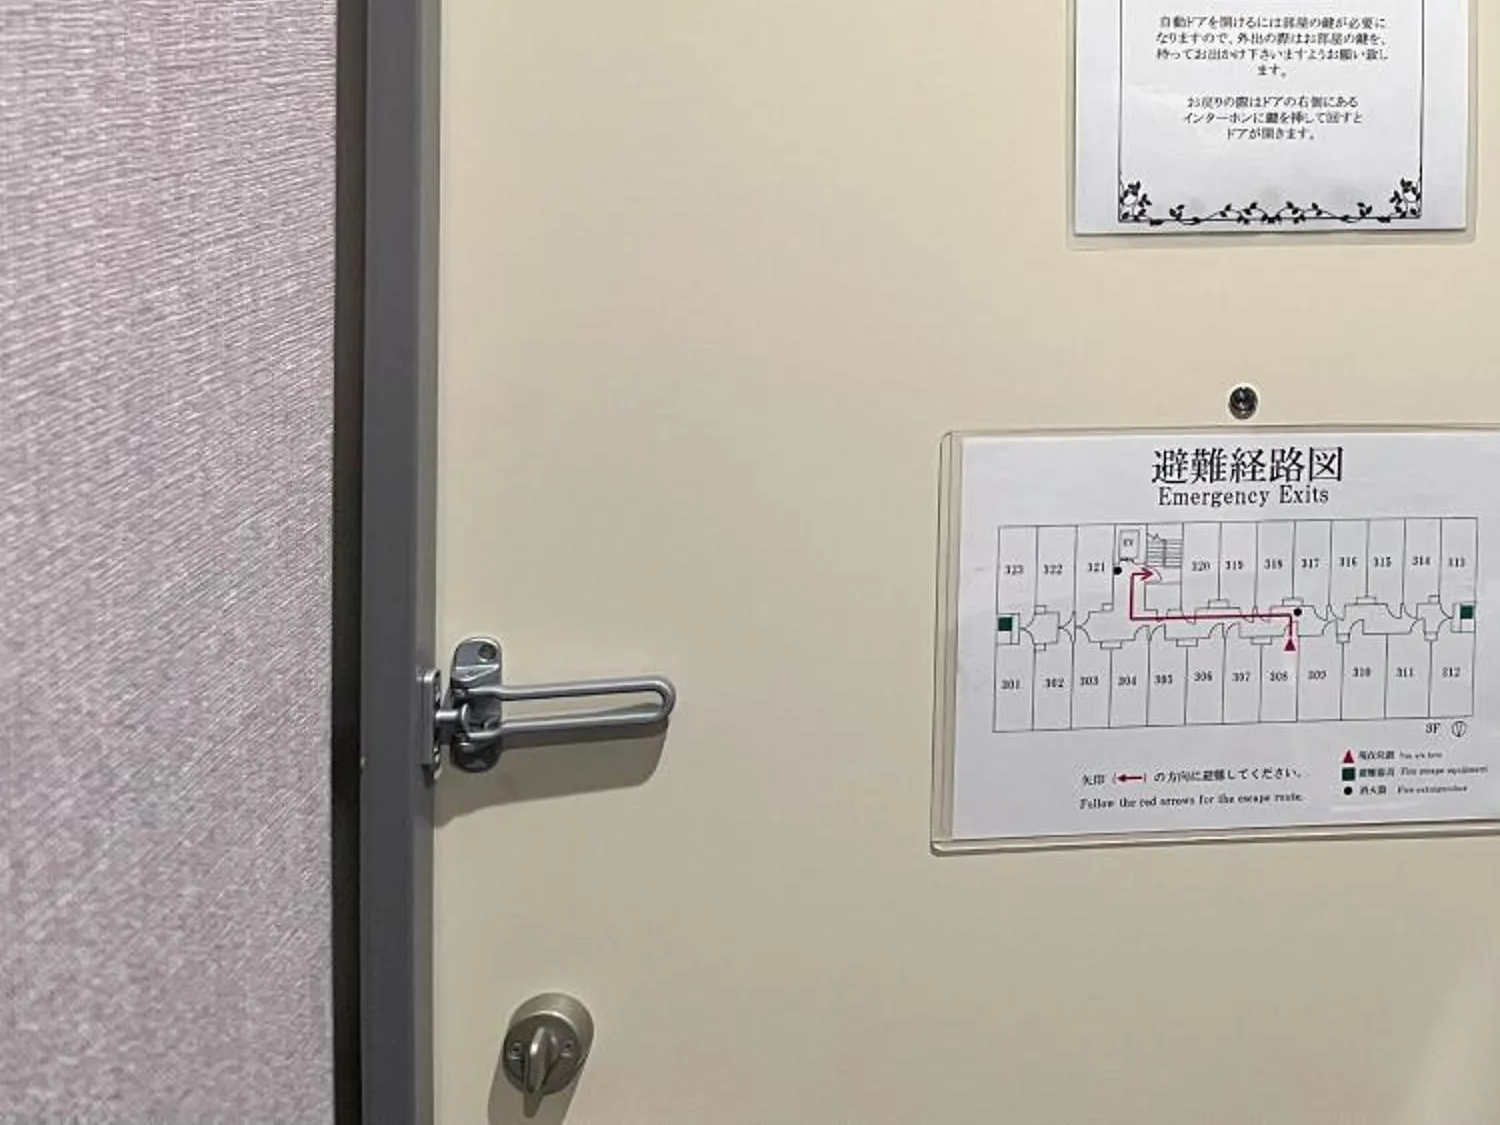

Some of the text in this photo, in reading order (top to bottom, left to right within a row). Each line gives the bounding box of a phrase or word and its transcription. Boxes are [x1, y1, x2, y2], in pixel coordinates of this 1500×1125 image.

[1257, 64, 1287, 78] ます。
[1226, 127, 1315, 140] ドアが開きます。
[1152, 446, 1343, 483] 避難経路図
[1159, 485, 1329, 507] Emergency Exits
[1301, 558, 1320, 568] 317
[1339, 557, 1358, 567] 316
[1080, 797, 1114, 809] Follow
[1119, 796, 1135, 808] the
[1139, 796, 1156, 807] red
[1160, 797, 1195, 806] arrows
[1199, 794, 1215, 804] for
[1218, 794, 1234, 804] the
[1238, 794, 1270, 804] escape
